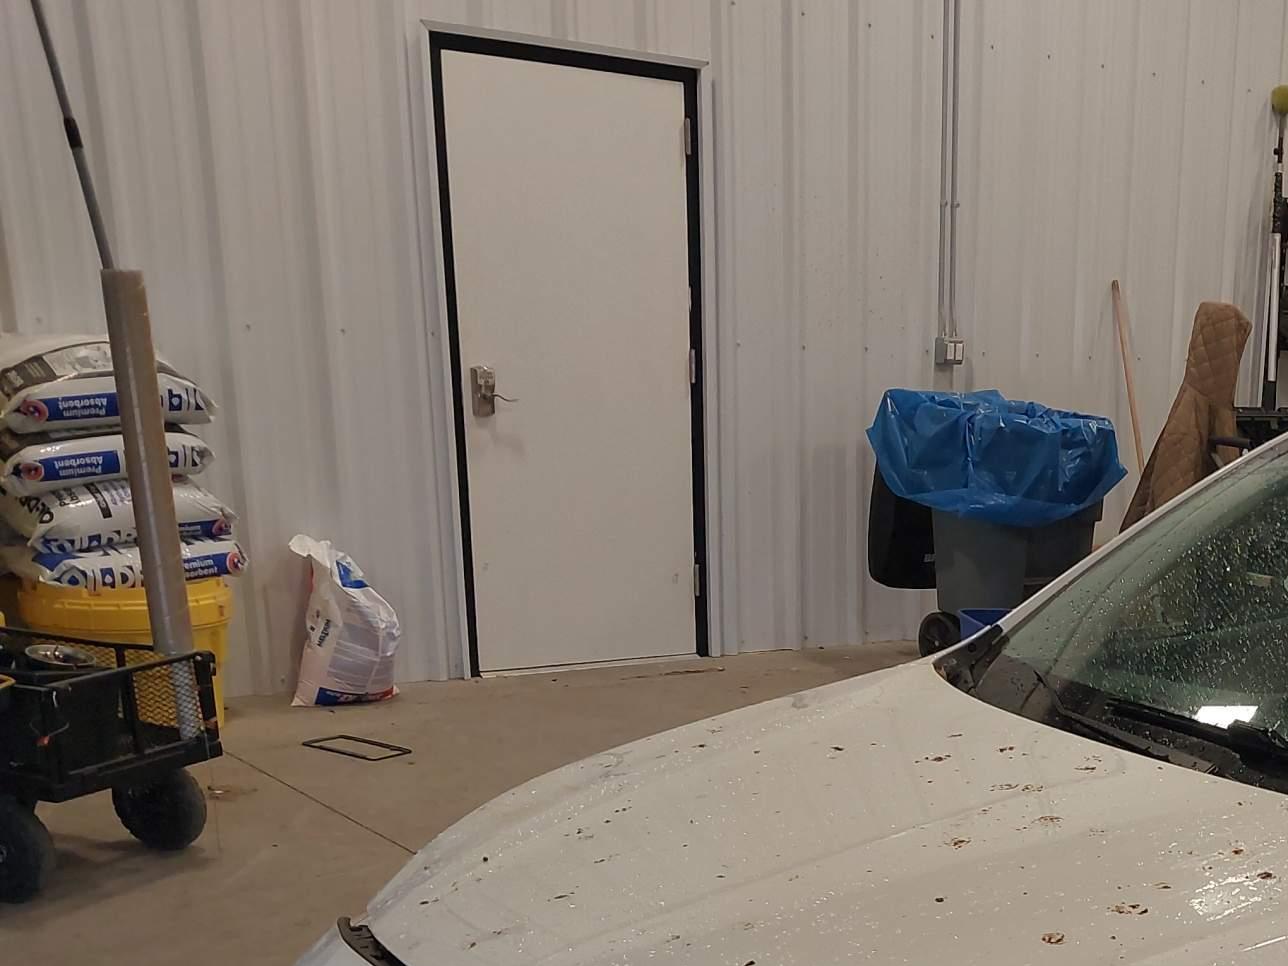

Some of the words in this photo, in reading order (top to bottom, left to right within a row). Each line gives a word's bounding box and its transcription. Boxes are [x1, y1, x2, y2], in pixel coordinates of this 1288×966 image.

[58, 396, 108, 411] Absorbent
[63, 408, 106, 419] Premium
[54, 455, 104, 470] Absorbent
[59, 465, 102, 479] Premium
[183, 557, 214, 570] emium
[184, 565, 219, 579] sorbent
